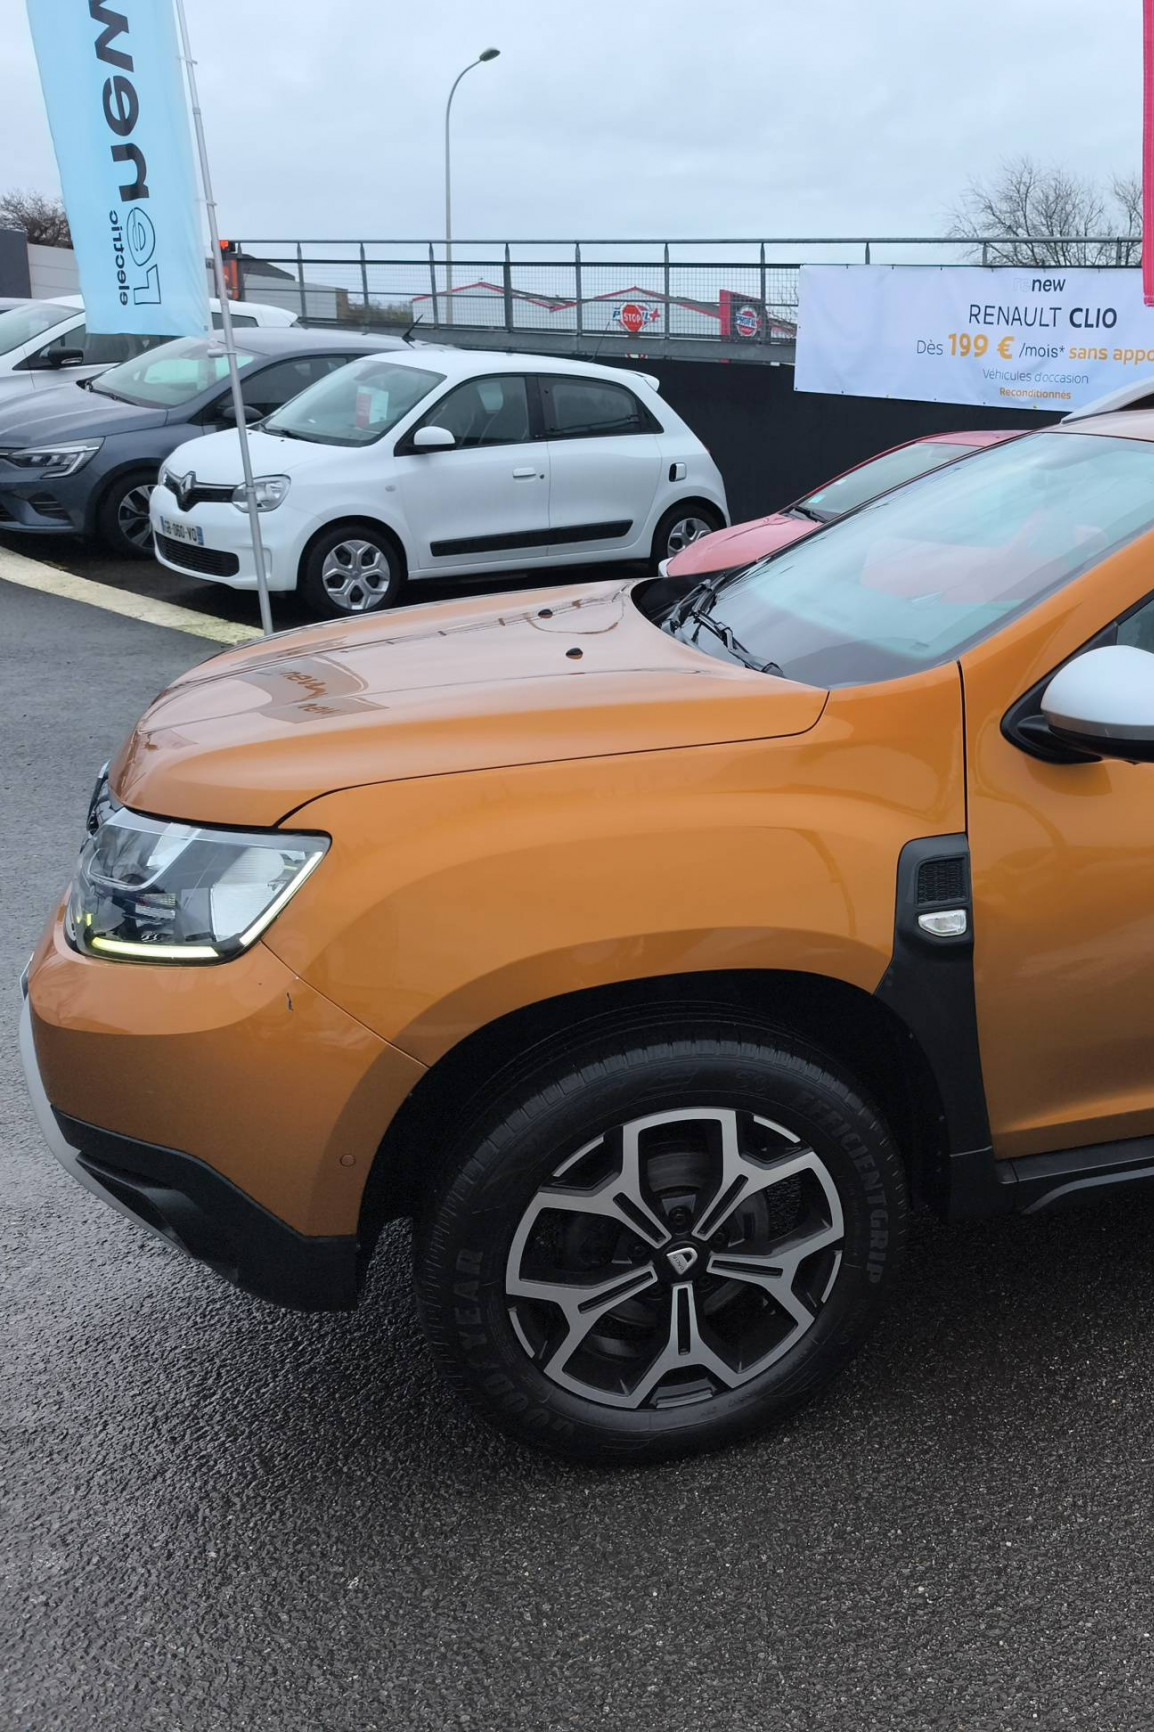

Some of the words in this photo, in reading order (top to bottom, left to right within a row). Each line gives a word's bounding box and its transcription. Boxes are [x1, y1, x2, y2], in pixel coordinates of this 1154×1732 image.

[623, 312, 641, 323] STOP
[969, 304, 1062, 327] RENAULT
[1069, 307, 1117, 328] CLIO
[916, 339, 944, 355] Dès
[948, 333, 989, 357] 199
[997, 336, 1015, 359] €
[1069, 347, 1108, 360] sans
[982, 368, 1032, 382] Véhicules
